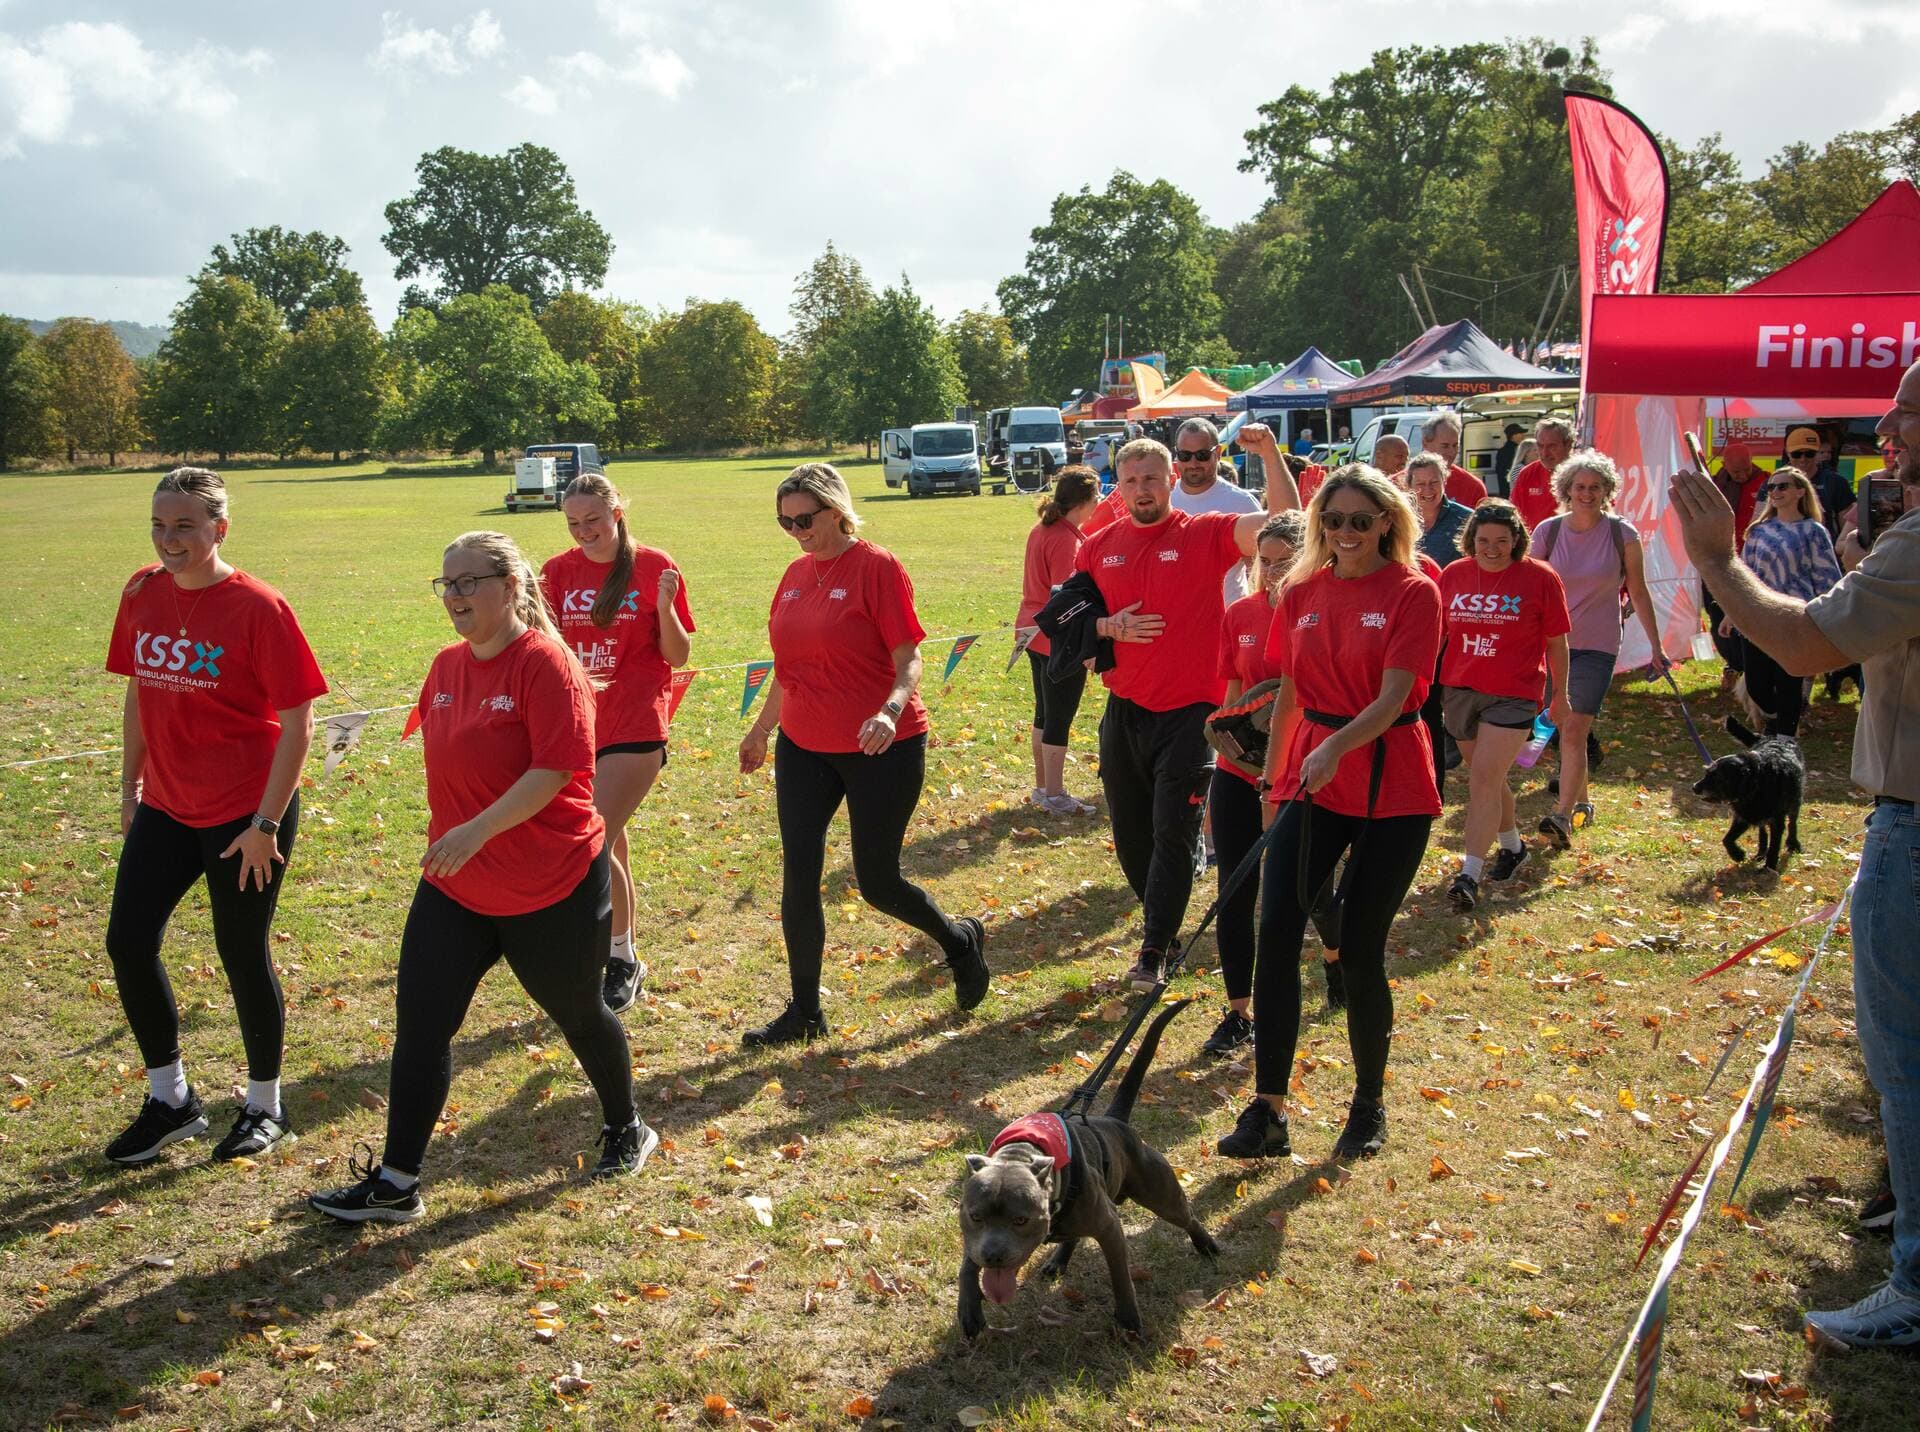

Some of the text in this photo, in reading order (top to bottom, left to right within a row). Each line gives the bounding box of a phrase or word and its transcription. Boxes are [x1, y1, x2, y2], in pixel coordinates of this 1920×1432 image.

[1756, 321, 1920, 369] Finish
[562, 589, 597, 612] KS
[1449, 593, 1500, 612] KSS
[1493, 613, 1520, 621] CHARITY
[134, 630, 193, 671] KSS
[137, 668, 220, 689] AMBULANCE CHARITY
[140, 679, 196, 693] SURREY SUSSEX
